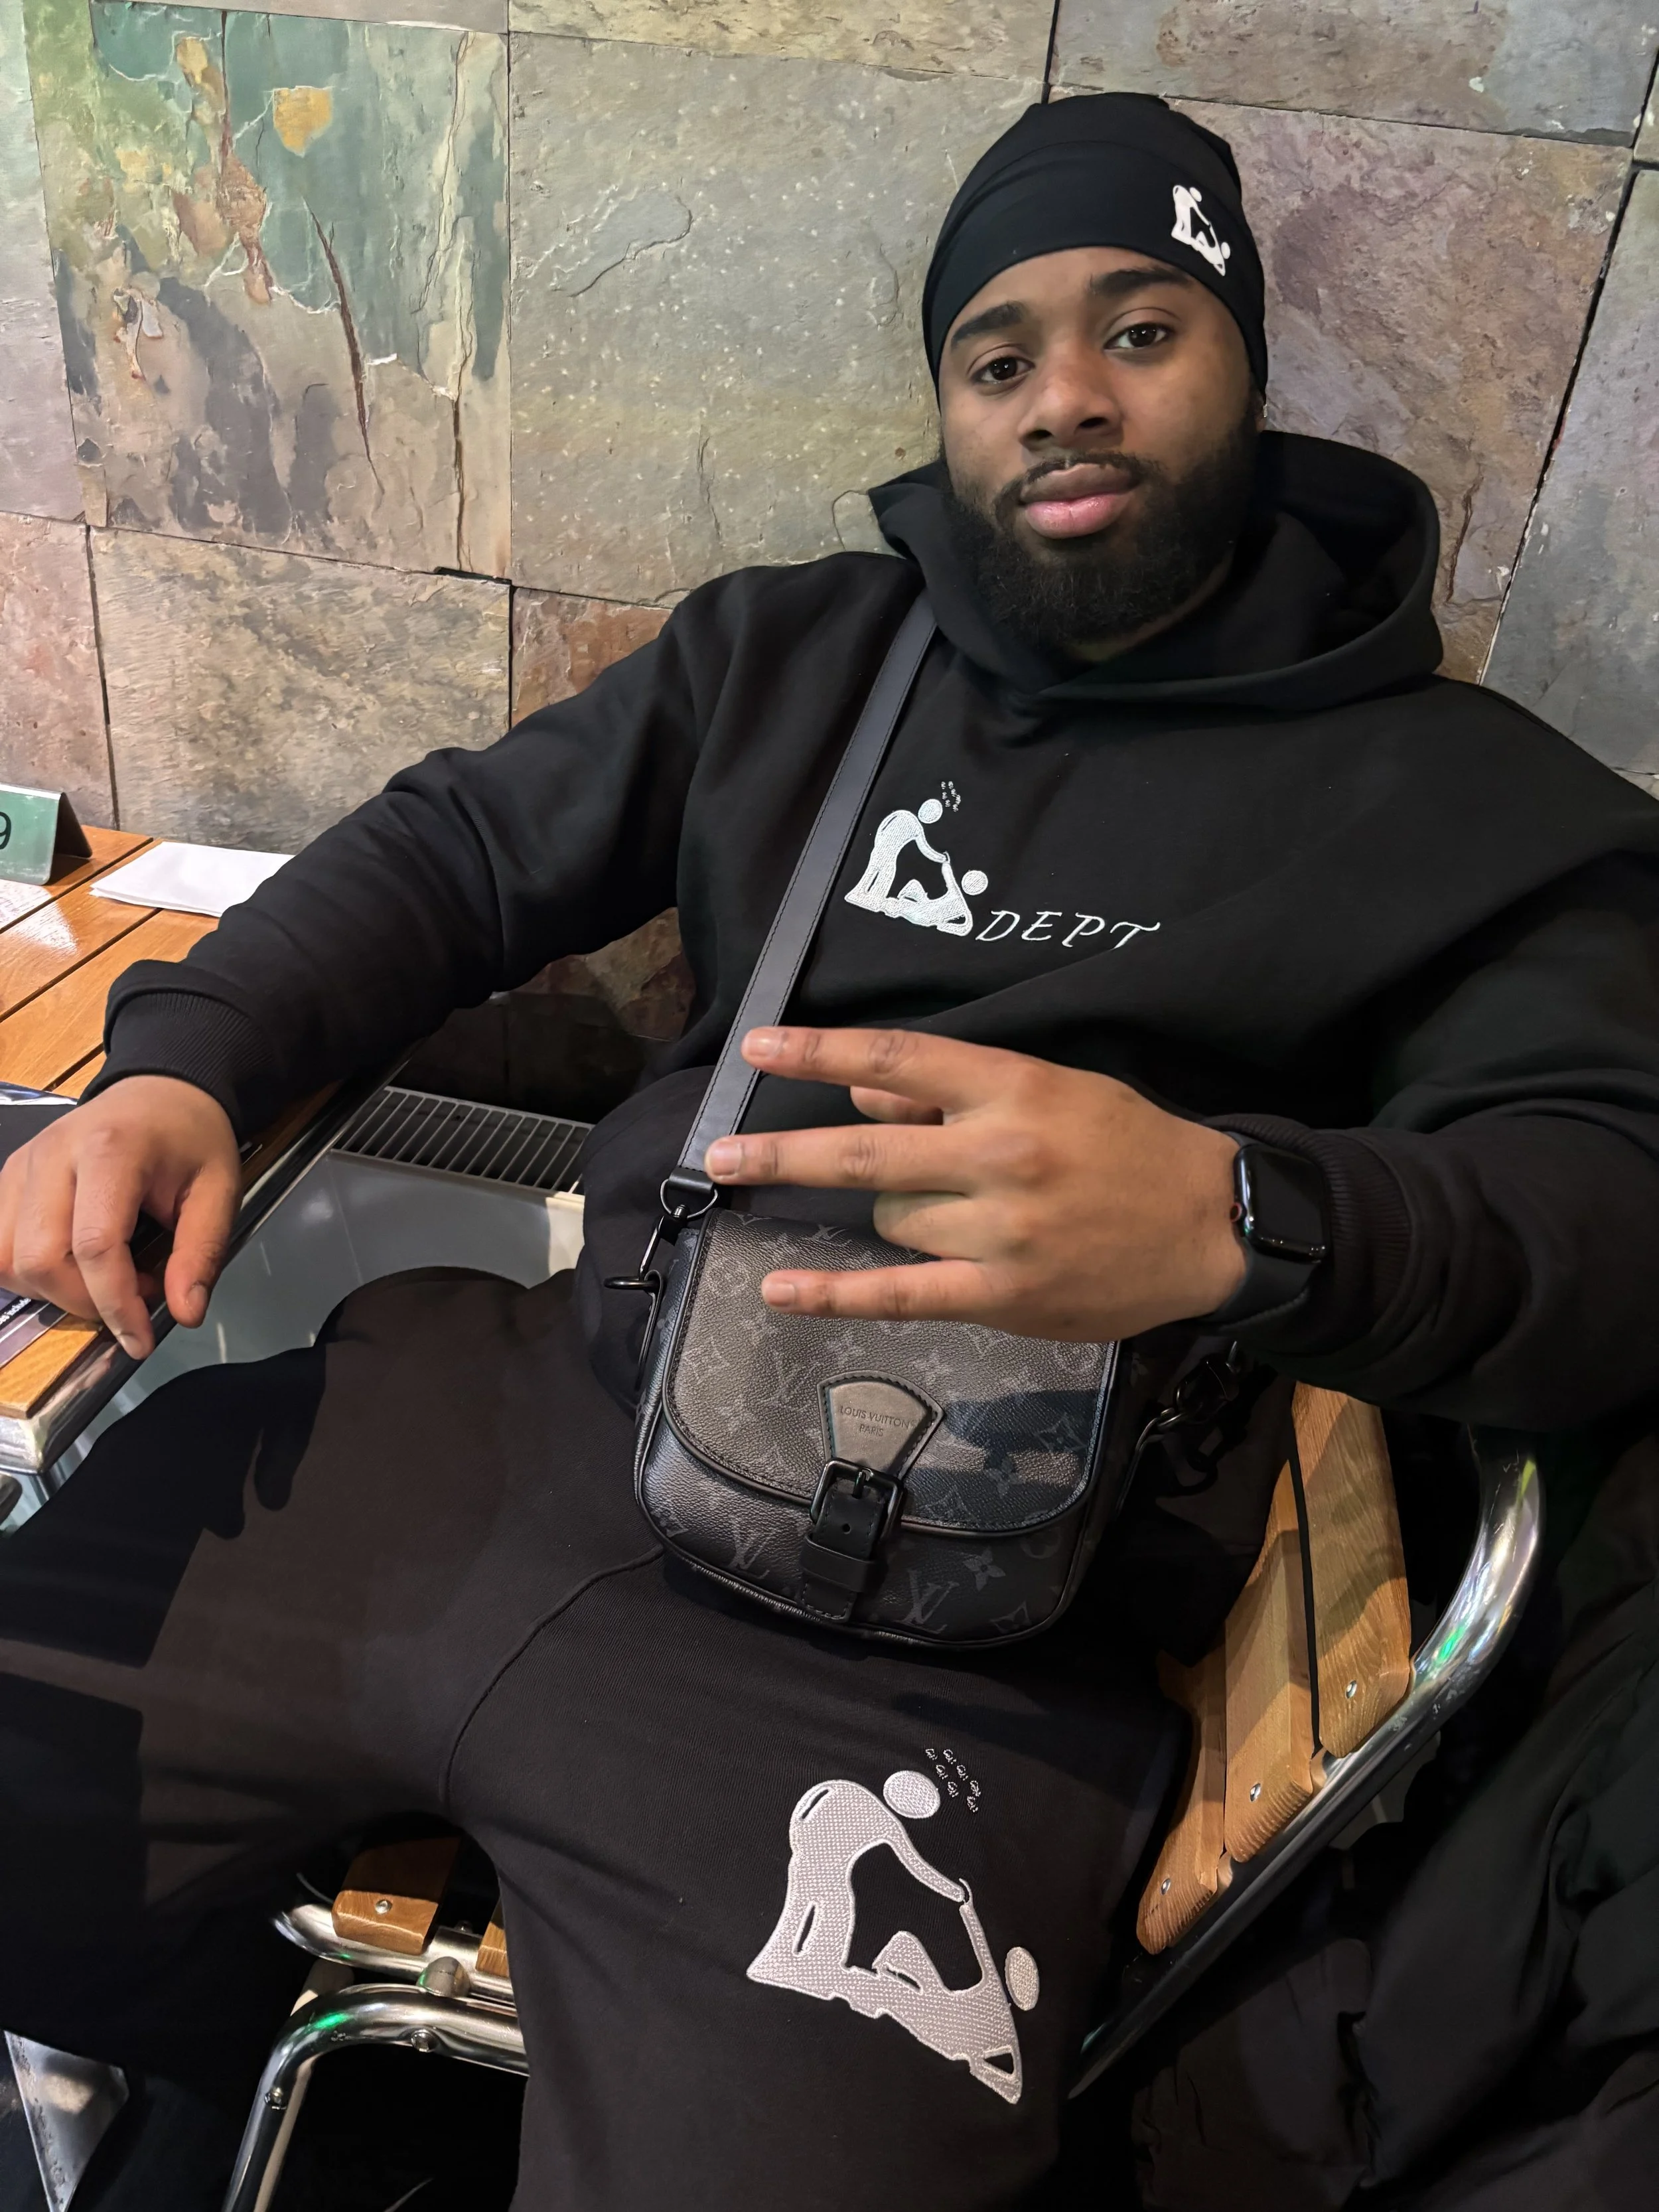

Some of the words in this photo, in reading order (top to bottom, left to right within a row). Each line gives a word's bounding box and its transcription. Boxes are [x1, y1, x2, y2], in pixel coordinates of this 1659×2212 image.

[975, 910, 1161, 950] DEPT
[839, 1405, 867, 1419] LOUIS
[869, 1412, 910, 1429] VUITTON
[859, 1424, 884, 1437] PARIS
